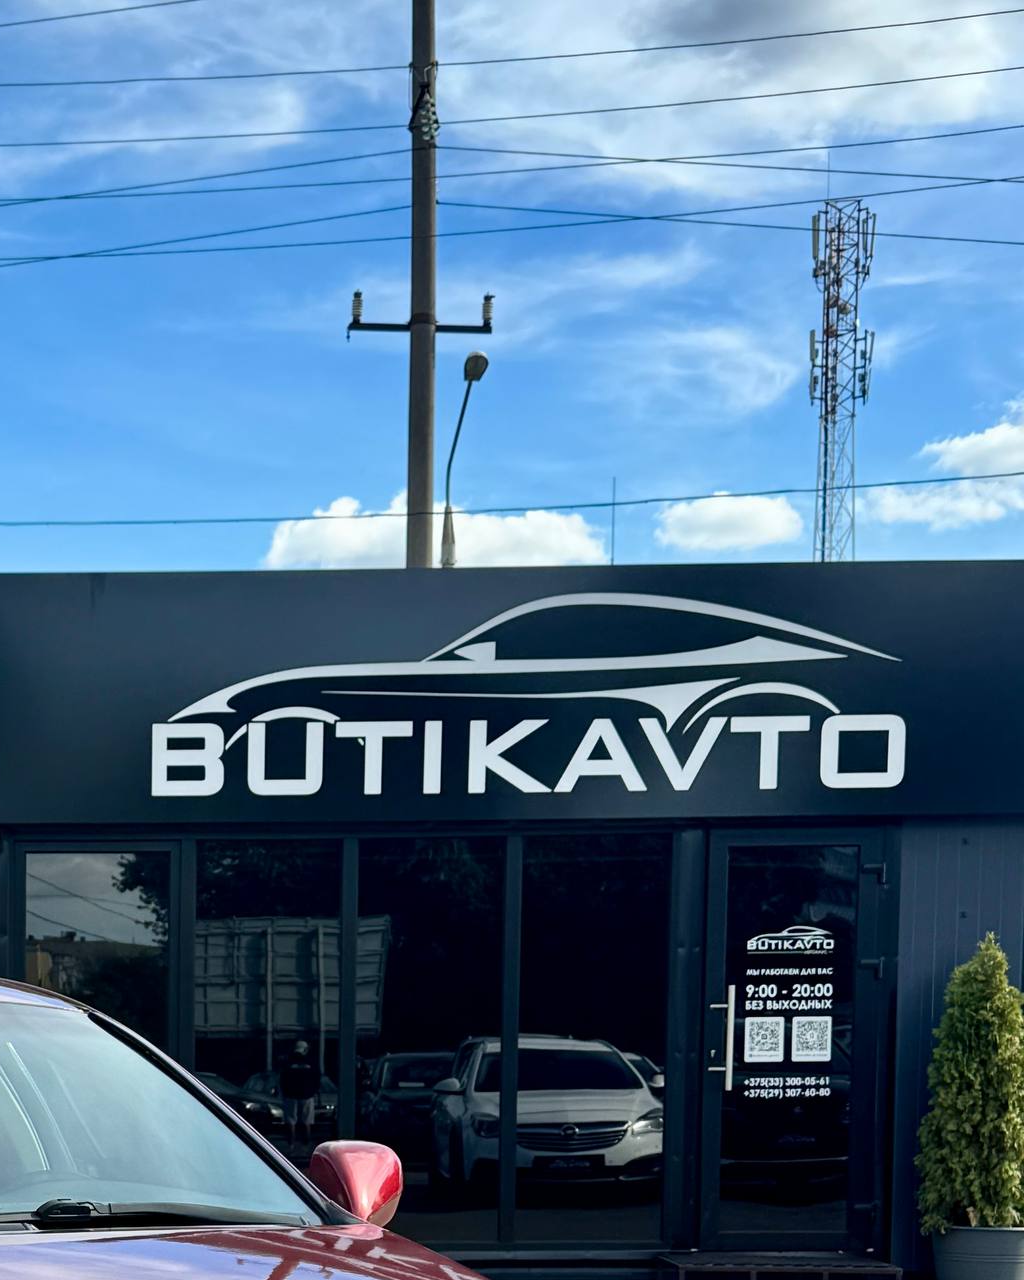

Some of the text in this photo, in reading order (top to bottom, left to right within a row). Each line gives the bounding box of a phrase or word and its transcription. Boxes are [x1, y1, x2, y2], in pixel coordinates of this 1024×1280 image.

[151, 712, 907, 797] BUTIKAVTO
[746, 939, 835, 950] BUTIKAVTO
[746, 967, 834, 976] МЫ РАБОТАЕМ ДЛЯ ВАС
[746, 984, 777, 998] 9:00
[792, 984, 833, 997] 20:00
[745, 1000, 833, 1011] БЕЗ ВЫХОДНЫХ
[744, 1077, 830, 1088] +375(33) 300-05-61
[744, 1088, 831, 1099] +375(29) 307-60-80
